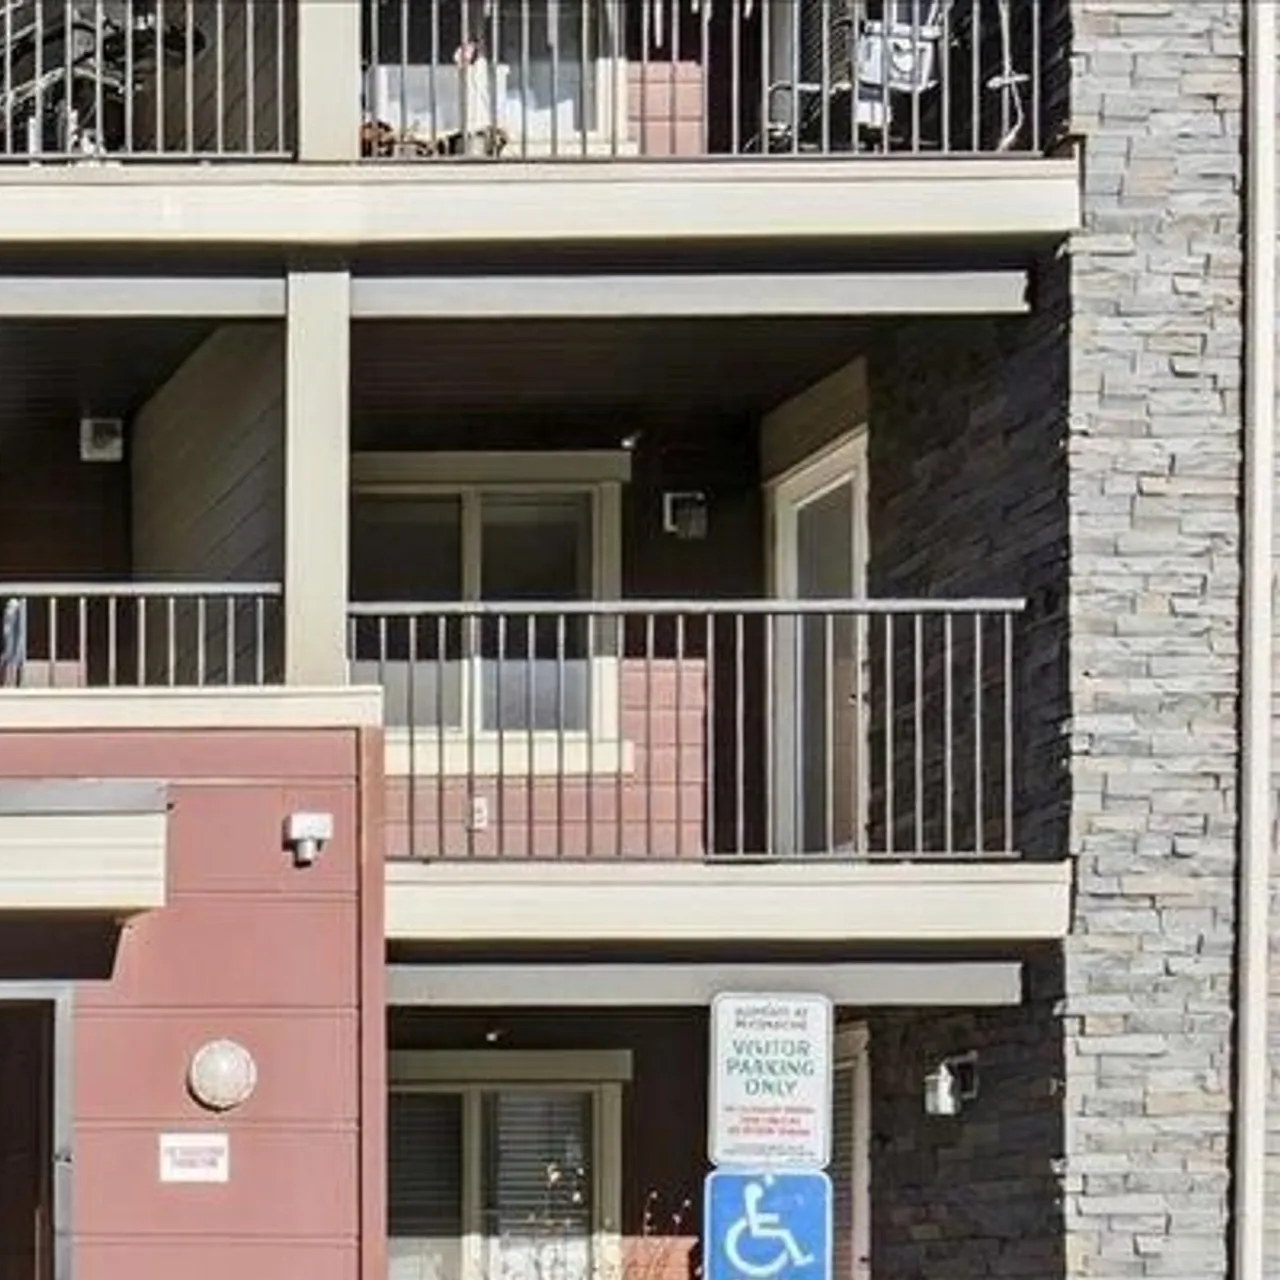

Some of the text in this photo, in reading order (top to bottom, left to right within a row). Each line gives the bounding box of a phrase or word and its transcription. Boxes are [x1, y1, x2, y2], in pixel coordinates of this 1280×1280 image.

[732, 1039, 812, 1057] VISITOR
[726, 1058, 815, 1077] PARKING
[744, 1078, 798, 1097] ONLY
